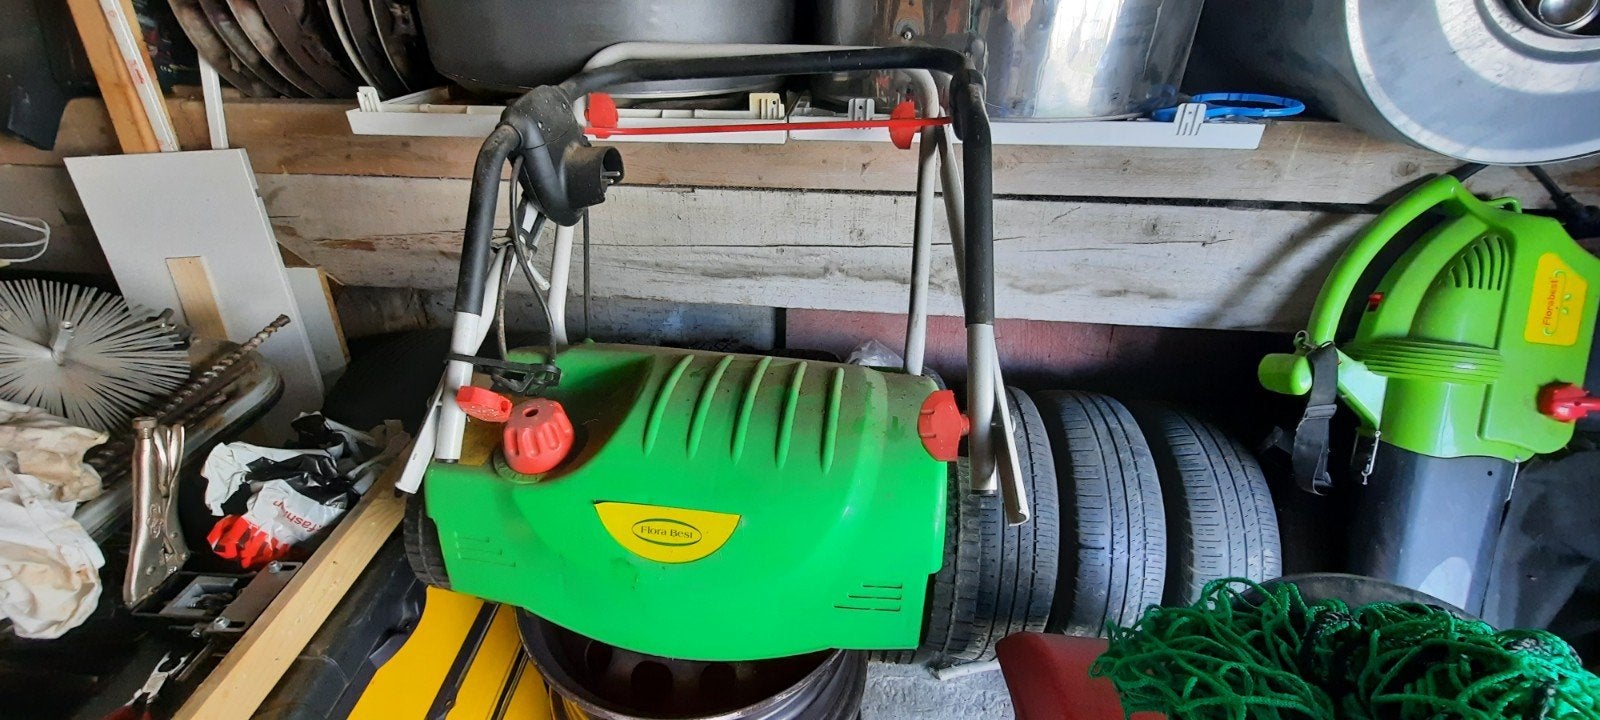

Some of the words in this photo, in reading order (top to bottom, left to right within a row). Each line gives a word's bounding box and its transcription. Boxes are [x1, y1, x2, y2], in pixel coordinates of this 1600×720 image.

[273, 500, 317, 533] fashin
[641, 525, 667, 536] Flora
[670, 528, 693, 539] Best
